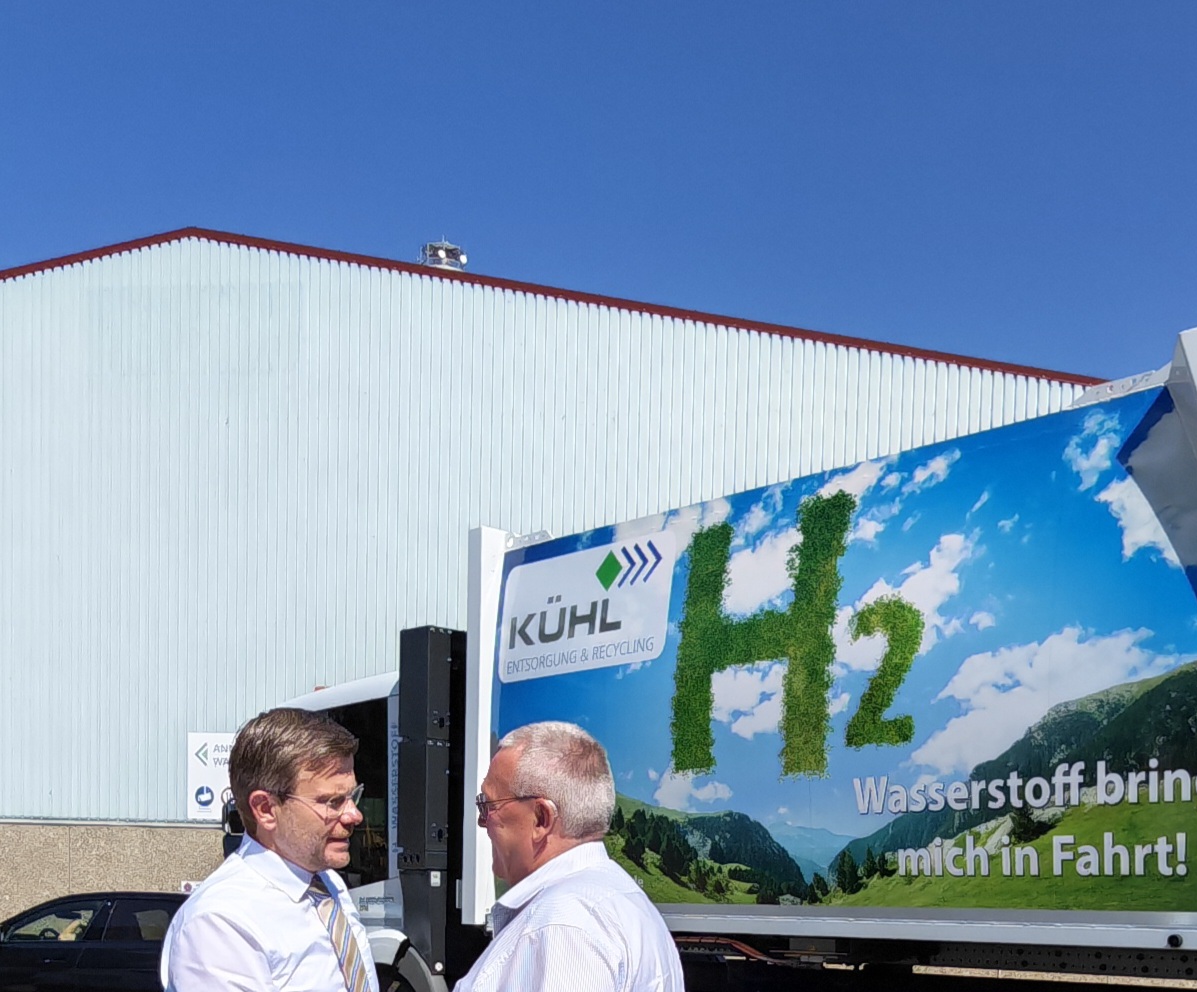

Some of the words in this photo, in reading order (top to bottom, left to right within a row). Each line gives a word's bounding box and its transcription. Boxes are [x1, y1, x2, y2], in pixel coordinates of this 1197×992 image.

[508, 594, 622, 650] KÜHL
[506, 650, 577, 675] ENTSORGUNG
[580, 648, 589, 663] &
[592, 636, 655, 660] RECYCLING
[852, 764, 1085, 816] Wasserstoff
[898, 834, 990, 878] mich
[1000, 834, 1040, 878] in
[1051, 831, 1189, 878] Fahrt!
